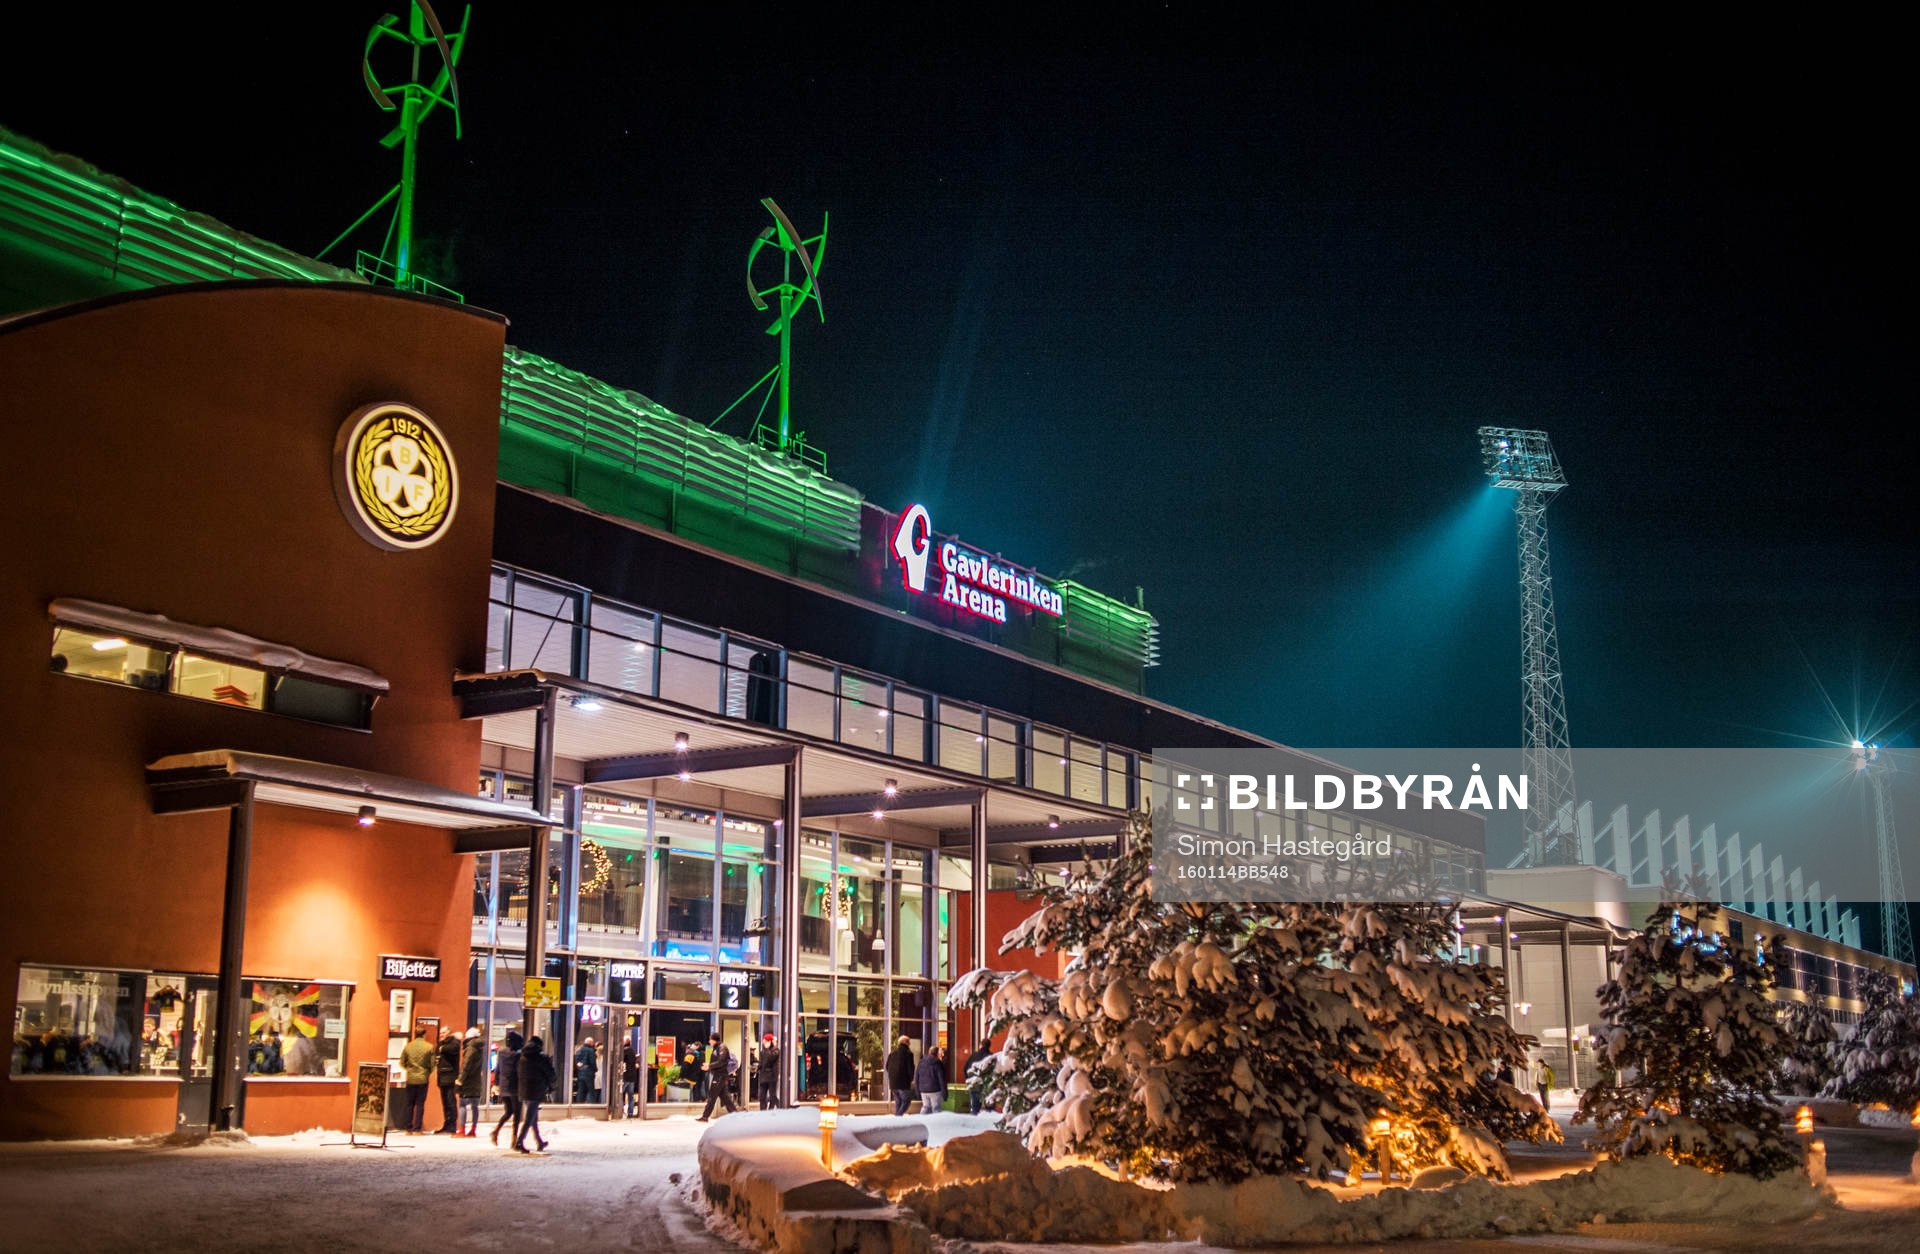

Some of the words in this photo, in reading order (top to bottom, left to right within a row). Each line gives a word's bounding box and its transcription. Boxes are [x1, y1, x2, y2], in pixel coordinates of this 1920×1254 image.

[392, 417, 421, 438] 1912
[400, 446, 412, 465] B
[414, 484, 424, 501] F
[940, 542, 1064, 616] Gavlerinken
[941, 573, 1007, 624] Arena
[385, 958, 438, 979] Biljetter
[611, 963, 646, 979] ENTRÉ
[719, 971, 749, 986] ENTRÉ
[622, 980, 632, 1002] 1
[728, 987, 739, 1008] 2
